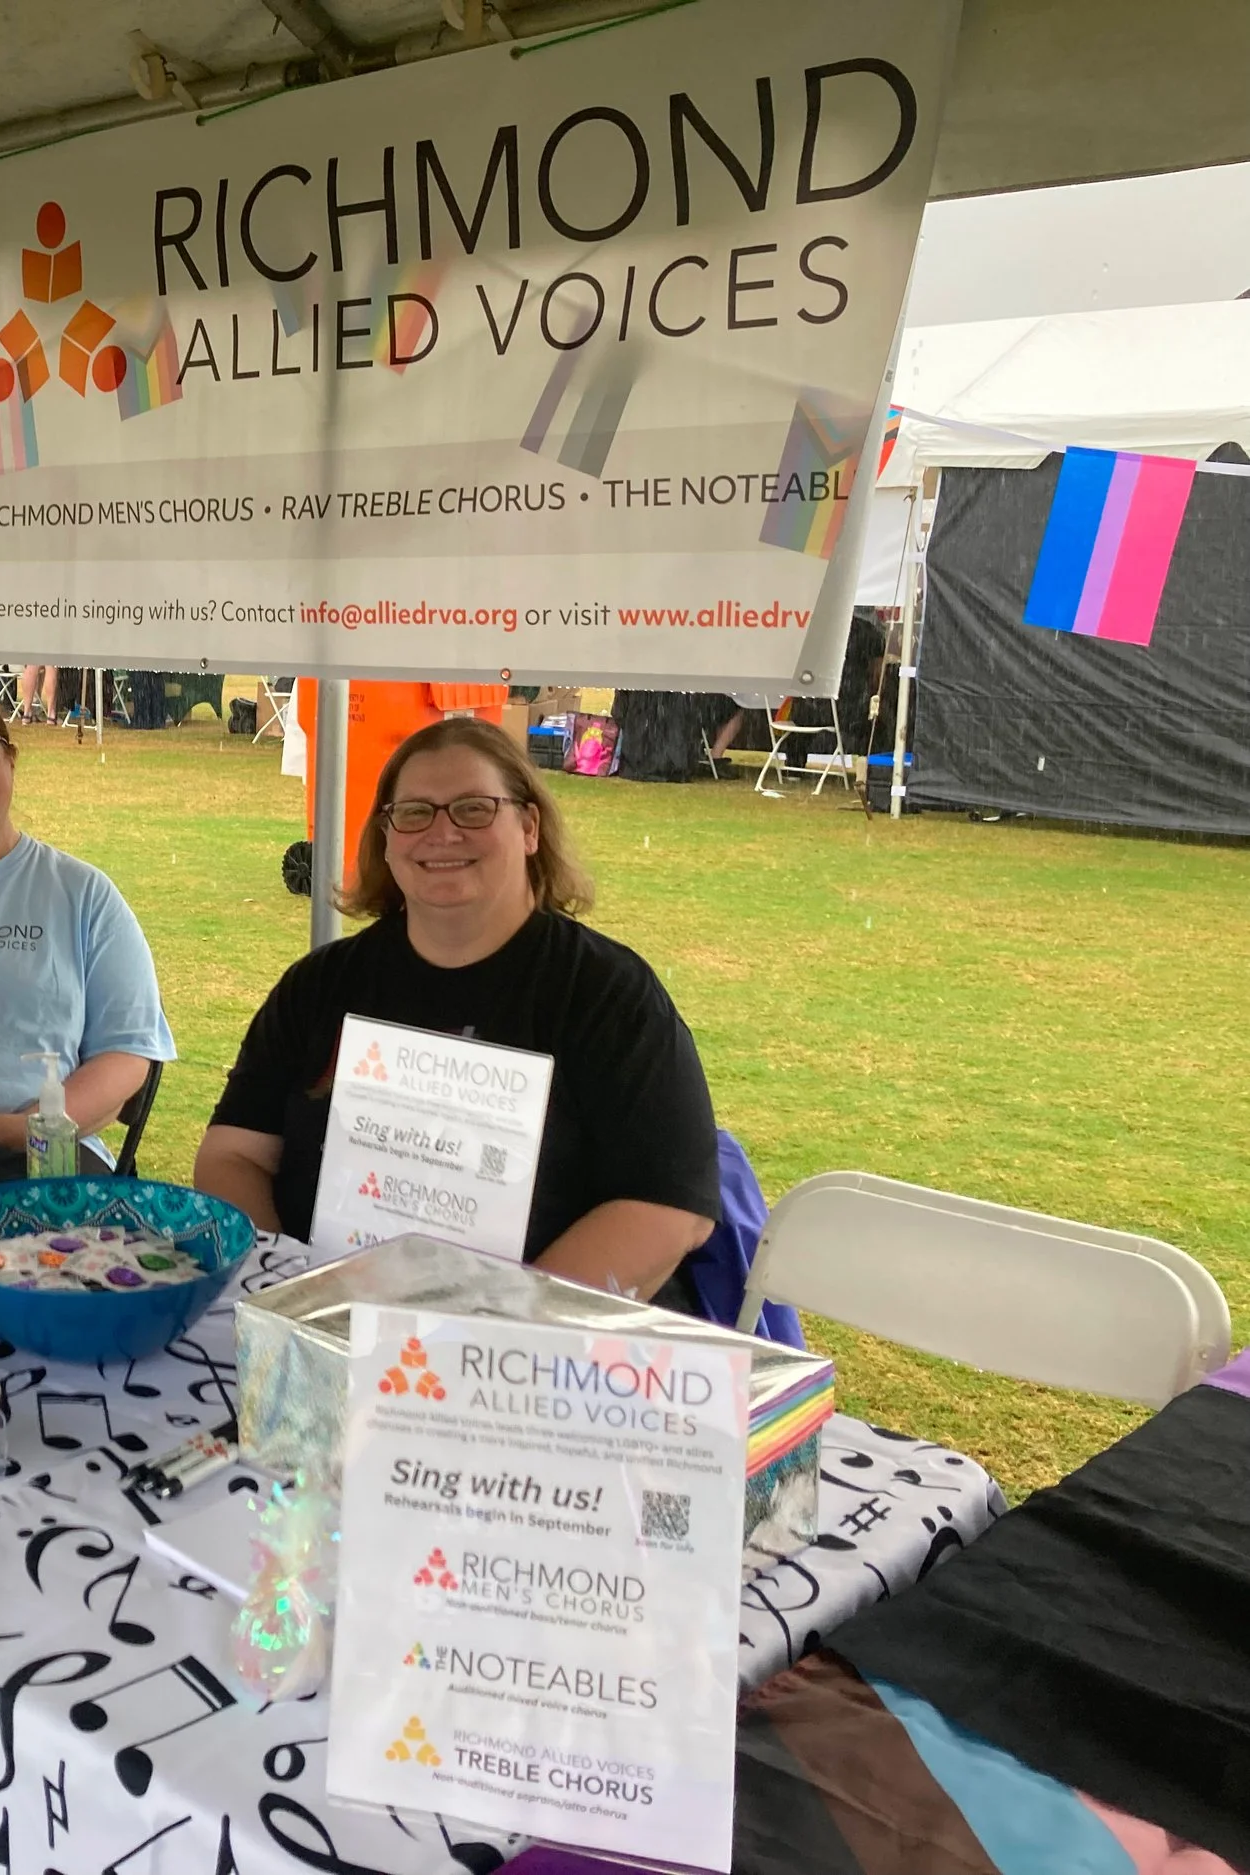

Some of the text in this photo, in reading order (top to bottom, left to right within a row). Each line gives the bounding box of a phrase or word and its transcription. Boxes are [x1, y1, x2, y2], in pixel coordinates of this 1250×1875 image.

[154, 58, 917, 295] RICHMOND
[177, 235, 849, 386] ALLIED VOICES
[98, 500, 155, 525] MEN'S
[159, 497, 254, 523] CHORUS
[282, 494, 332, 520] RAV
[337, 489, 433, 518] TREBLE
[438, 482, 565, 514] CHORUS
[602, 477, 671, 508] THE
[681, 470, 850, 506] NOTEABL
[64, 599, 77, 619] in
[82, 600, 144, 625] singing
[149, 599, 185, 621] with
[190, 600, 216, 622] us?
[221, 601, 295, 623] Contact
[300, 600, 517, 632] info@alliedrva.org
[525, 608, 552, 626] or
[559, 602, 611, 626] visit
[617, 600, 810, 628] www.alliedrv
[396, 1046, 528, 1094] RICHMOND
[399, 1077, 453, 1099] ALLIED
[458, 1087, 517, 1113] VOICES
[353, 1115, 463, 1157] Sing with us!
[383, 1175, 478, 1214] RICHMOND
[424, 1204, 476, 1227] CHORUS
[461, 1344, 713, 1407] RICHMOND
[469, 1387, 698, 1436] ALLIED VOICES
[390, 1457, 604, 1512] Sing with us!
[666, 1457, 723, 1475] Richmond
[384, 1492, 612, 1538] Rehearsals begin in September
[462, 1551, 646, 1603] RICHMOND
[460, 1579, 645, 1624] MEN'S CHORUS
[590, 1620, 628, 1636] chorus
[435, 1645, 658, 1710] THE NOTEABLES
[447, 1683, 608, 1720] Auditioned mixed voice chorus
[453, 1729, 655, 1782] RICHMOND ALLIED VOICES
[454, 1747, 655, 1806] TREBLE CHORUS
[431, 1770, 628, 1821] Non-auditioned soprano/alto chorus
